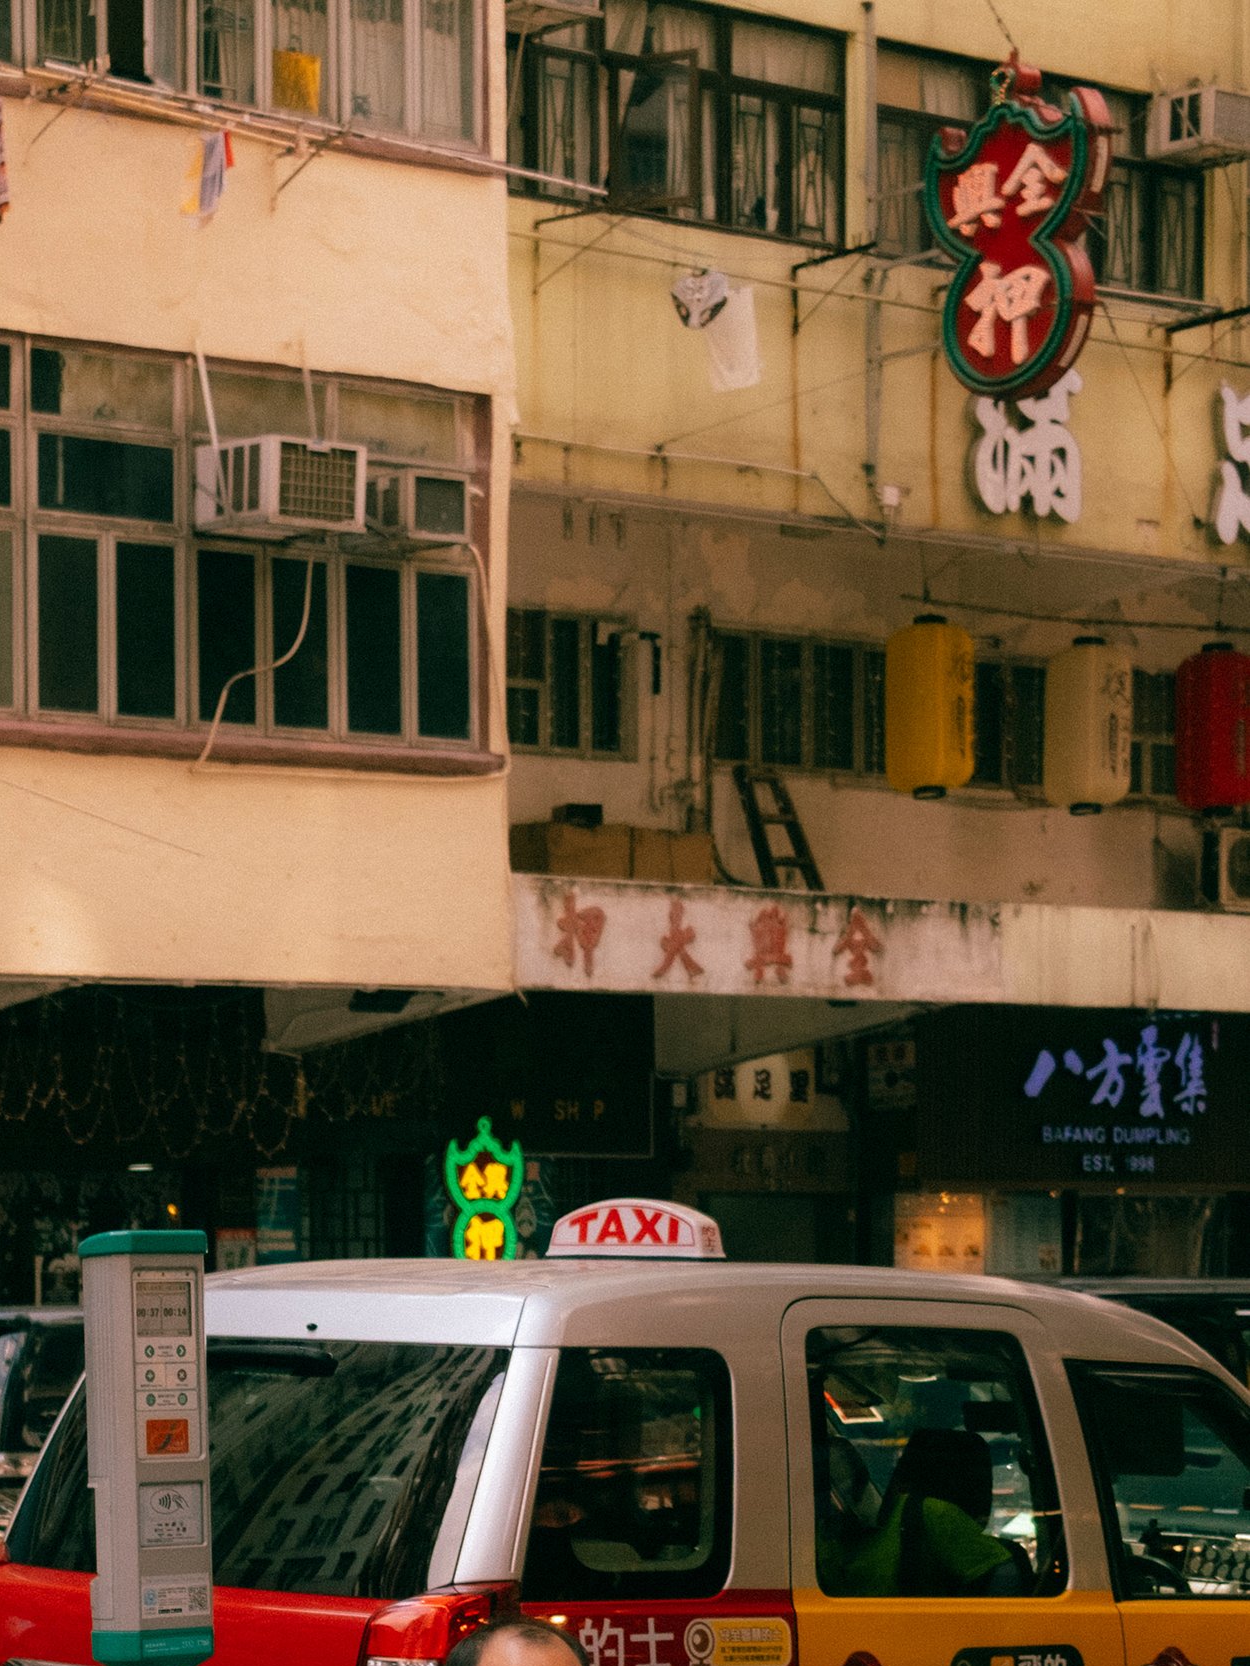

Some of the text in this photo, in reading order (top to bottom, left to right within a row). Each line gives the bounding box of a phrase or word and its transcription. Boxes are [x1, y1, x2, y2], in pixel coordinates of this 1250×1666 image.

[1041, 1126, 1191, 1145] BAFANG DUMPLING
[569, 1207, 679, 1243] TAXI
